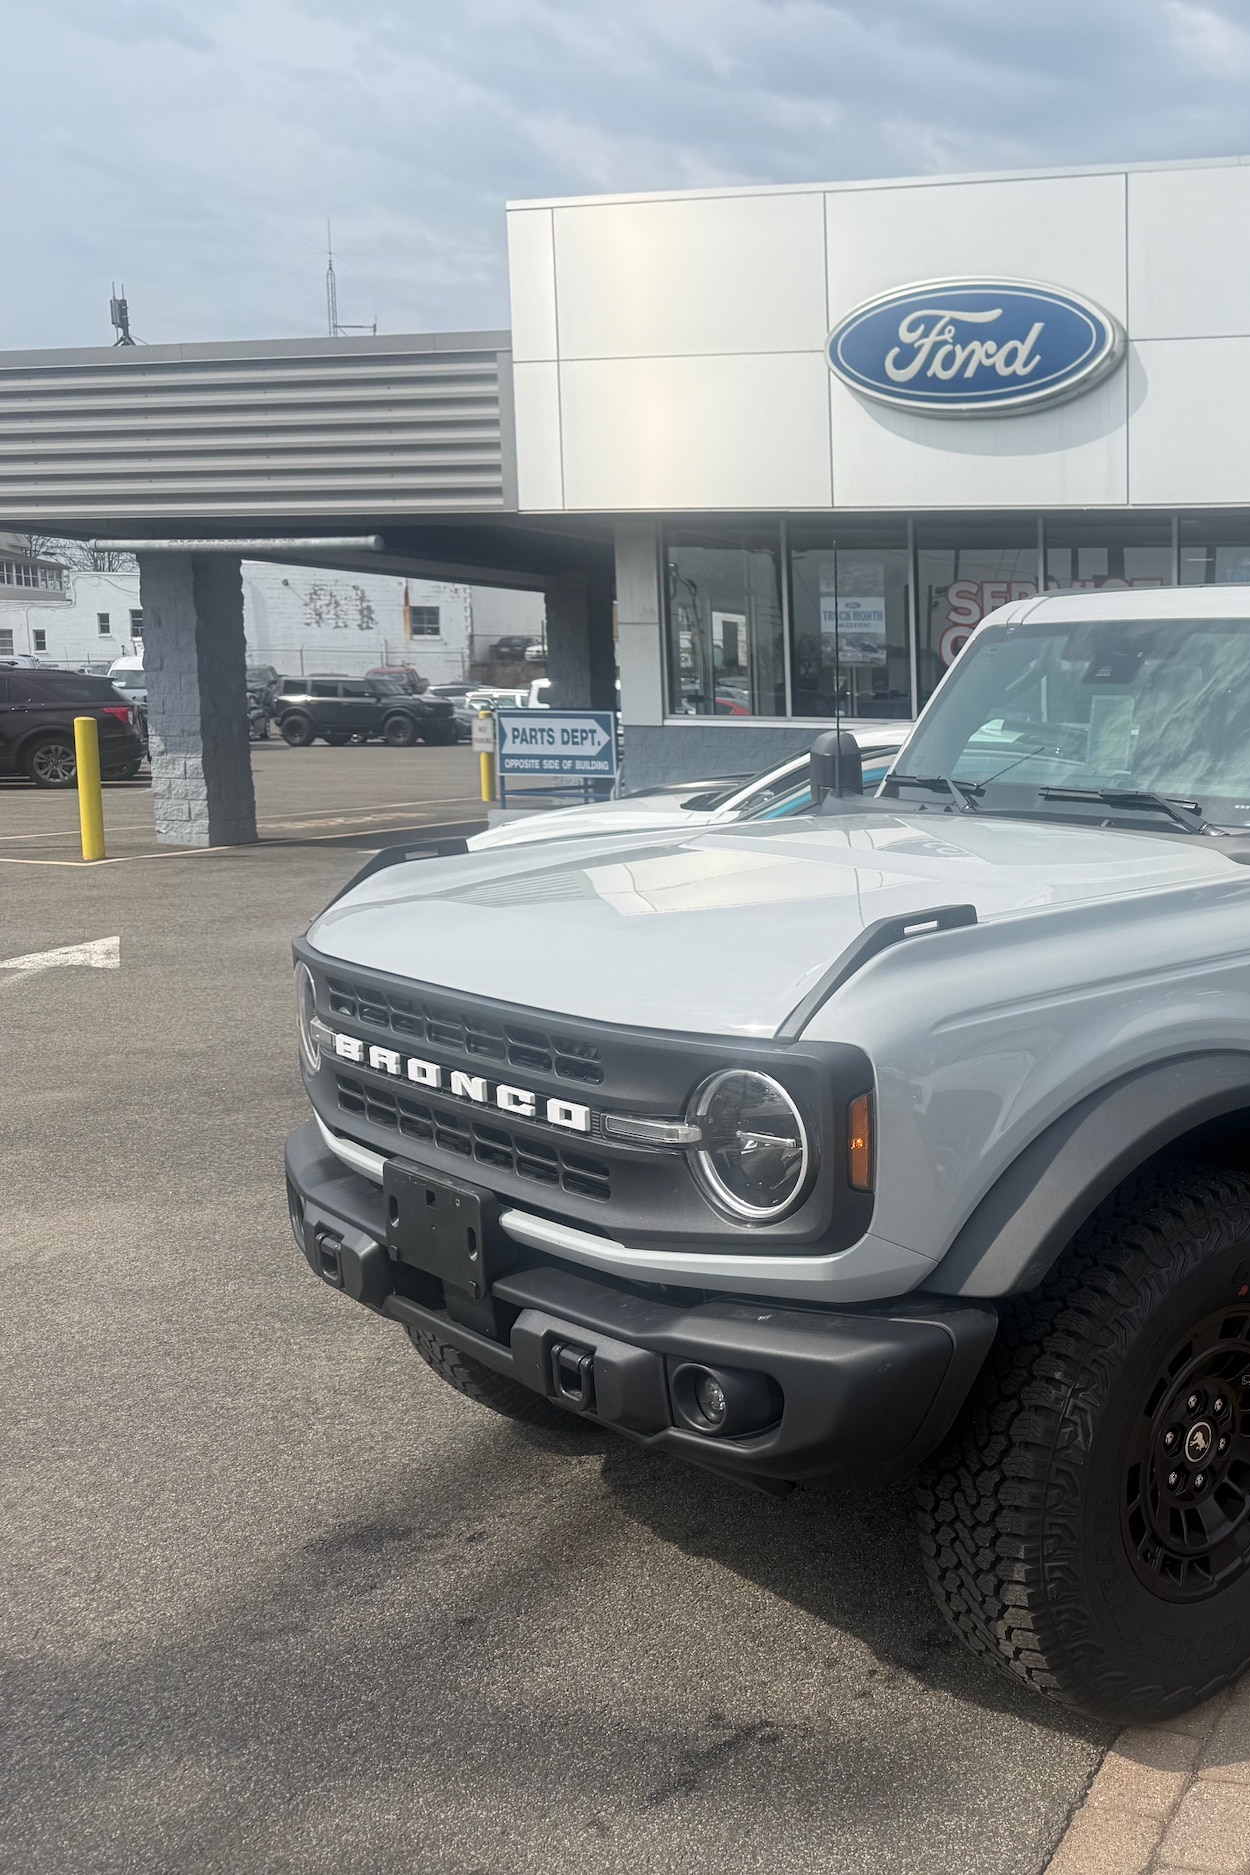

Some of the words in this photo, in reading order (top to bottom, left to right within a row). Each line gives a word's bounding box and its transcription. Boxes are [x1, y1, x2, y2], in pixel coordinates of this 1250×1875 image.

[884, 308, 1046, 382] Ford
[511, 727, 555, 745] PARTS
[561, 729, 600, 746] DEPT.
[504, 758, 540, 770] OPPOSITE
[543, 759, 560, 770] SIDE
[562, 760, 573, 770] OF
[575, 760, 609, 771] BUILDING
[335, 1033, 590, 1131] BRONCO
